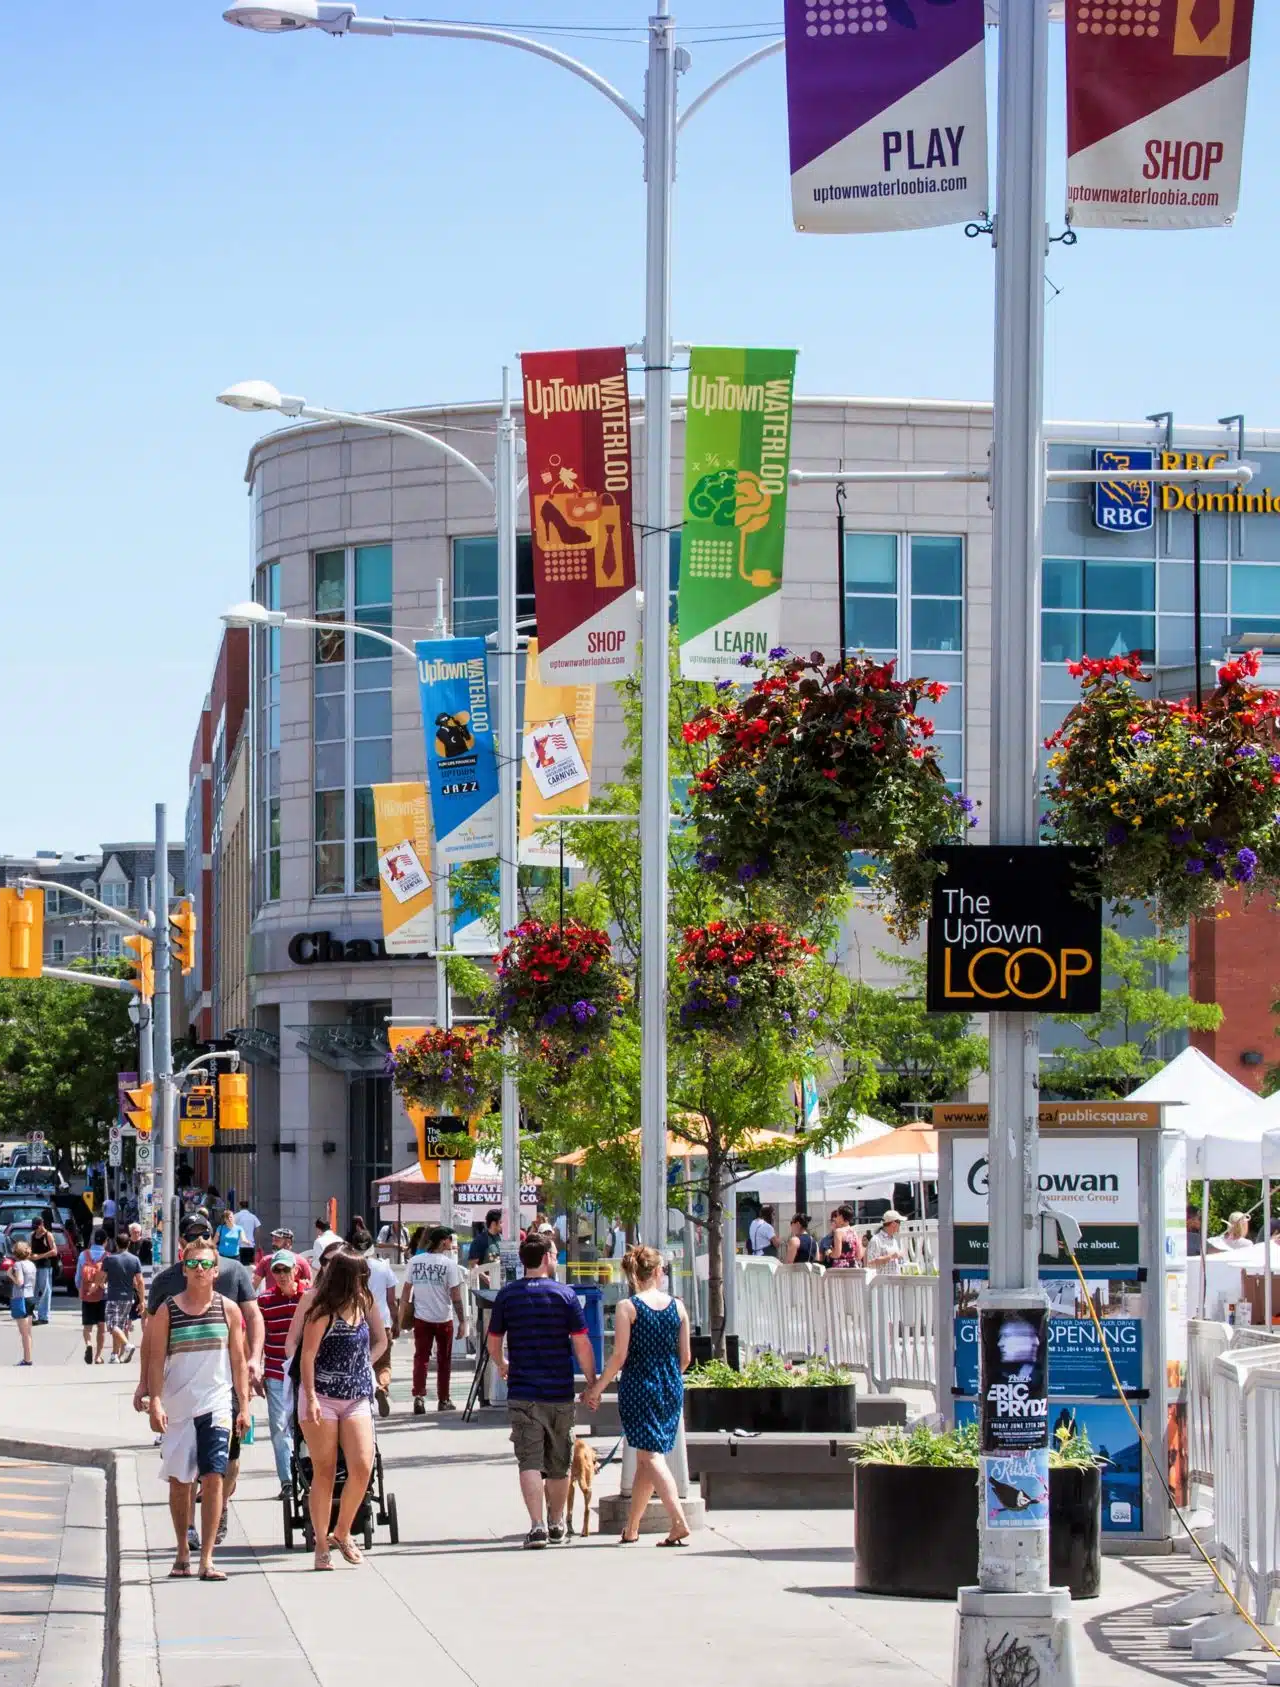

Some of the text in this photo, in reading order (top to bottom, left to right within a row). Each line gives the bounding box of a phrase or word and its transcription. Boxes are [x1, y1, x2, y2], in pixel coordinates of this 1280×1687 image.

[883, 126, 964, 171] PLAY
[1142, 139, 1224, 181] SHOP
[813, 176, 967, 203] uptownwaterloobia.com
[1068, 184, 1219, 206] uptownwaterloobia.com
[526, 377, 601, 420] UpTown
[690, 375, 765, 416] UpTown
[600, 375, 629, 491] WATERLOO
[759, 379, 791, 495] WATERLOO
[1102, 507, 1148, 526] RBC
[587, 630, 626, 653] SHOP
[714, 630, 768, 654] LEARN
[418, 658, 470, 686] UpTown
[468, 657, 489, 733] WATERLOO
[547, 767, 578, 785] CARNIVAL
[443, 782, 478, 794] JAZZ
[942, 887, 991, 914] The
[943, 918, 1042, 950] UpTown
[944, 947, 1093, 999] LOOP
[468, 1184, 537, 1193] WATEOO
[1037, 1174, 1119, 1192] owan
[458, 1193, 538, 1203] BREWI CO.
[1040, 1192, 1119, 1204] nsurance Group
[969, 1240, 981, 1249] We
[1090, 1240, 1120, 1249] about.
[413, 1262, 447, 1276] TRASH
[413, 1270, 444, 1283] TALK
[987, 1383, 1029, 1401] ERIC
[996, 1398, 1048, 1417] PRYDZ
